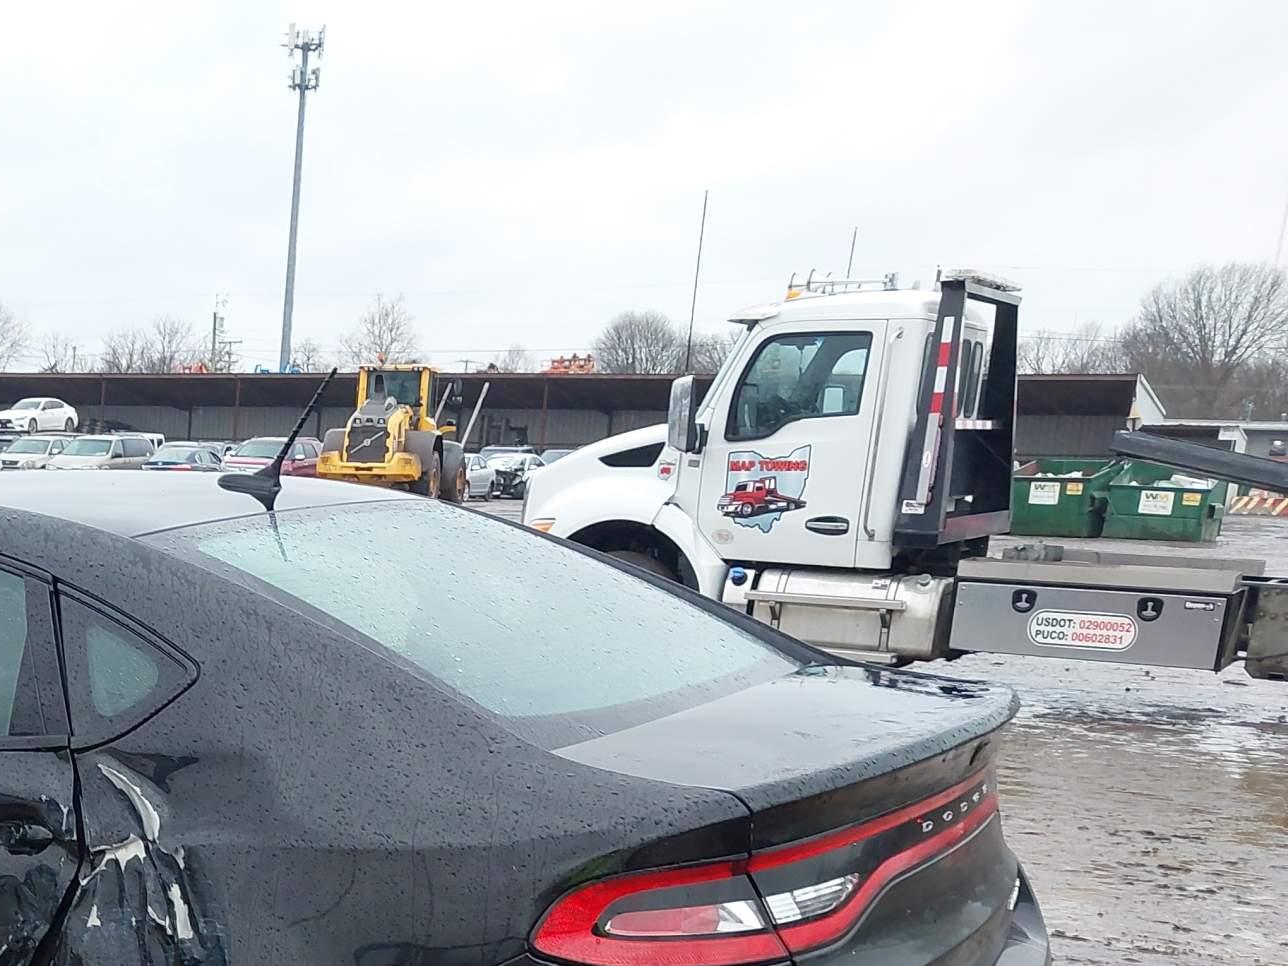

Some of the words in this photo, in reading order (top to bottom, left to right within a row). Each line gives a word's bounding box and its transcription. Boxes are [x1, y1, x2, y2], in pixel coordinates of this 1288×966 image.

[729, 460, 756, 472] MAP
[758, 460, 808, 472] TOWING
[1035, 616, 1076, 629] USDOT:
[1079, 619, 1132, 633] 02900052
[1034, 629, 1069, 641] PUCO:
[1071, 632, 1123, 645] 00602831
